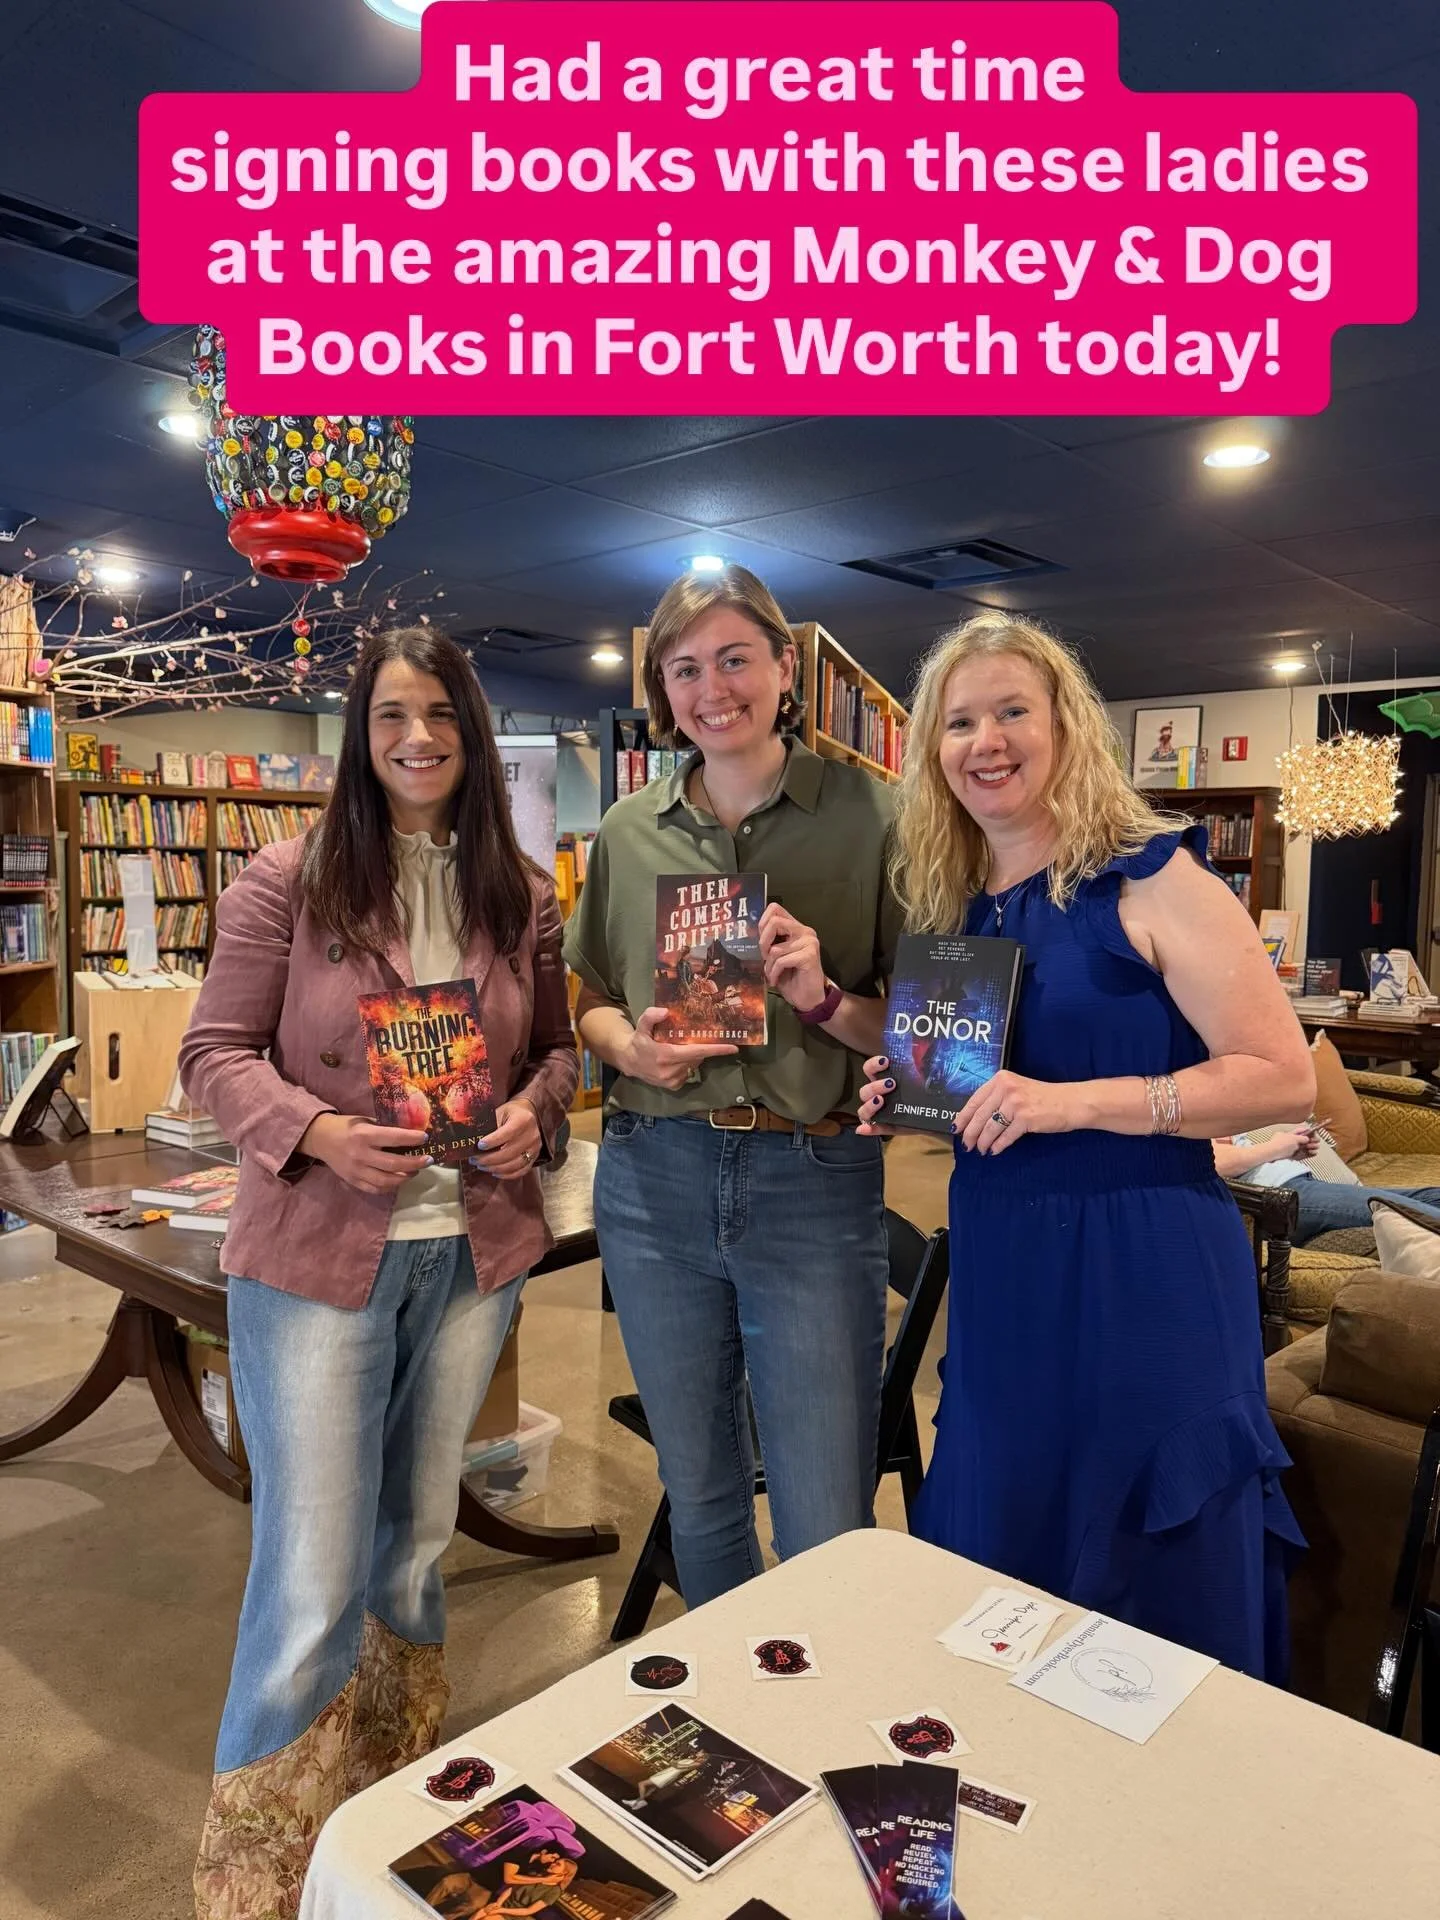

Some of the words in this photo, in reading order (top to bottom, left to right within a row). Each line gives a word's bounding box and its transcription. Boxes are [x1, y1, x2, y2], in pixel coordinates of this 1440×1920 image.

[677, 878, 729, 907] THEN
[670, 900, 732, 931] COMES
[737, 897, 748, 918] A
[664, 920, 749, 953] DRIFTER
[416, 1006, 433, 1020] THE
[926, 1000, 957, 1016] THE
[375, 1012, 477, 1058] BURNING
[893, 1013, 992, 1044] DONOR
[401, 1044, 457, 1079] TREE
[893, 1103, 938, 1118] JENNIFER
[404, 1143, 446, 1157] HELEN
[897, 1814, 952, 1832] READING
[904, 1869, 935, 1881] SKILLS
[908, 1863, 945, 1876] HACKING
